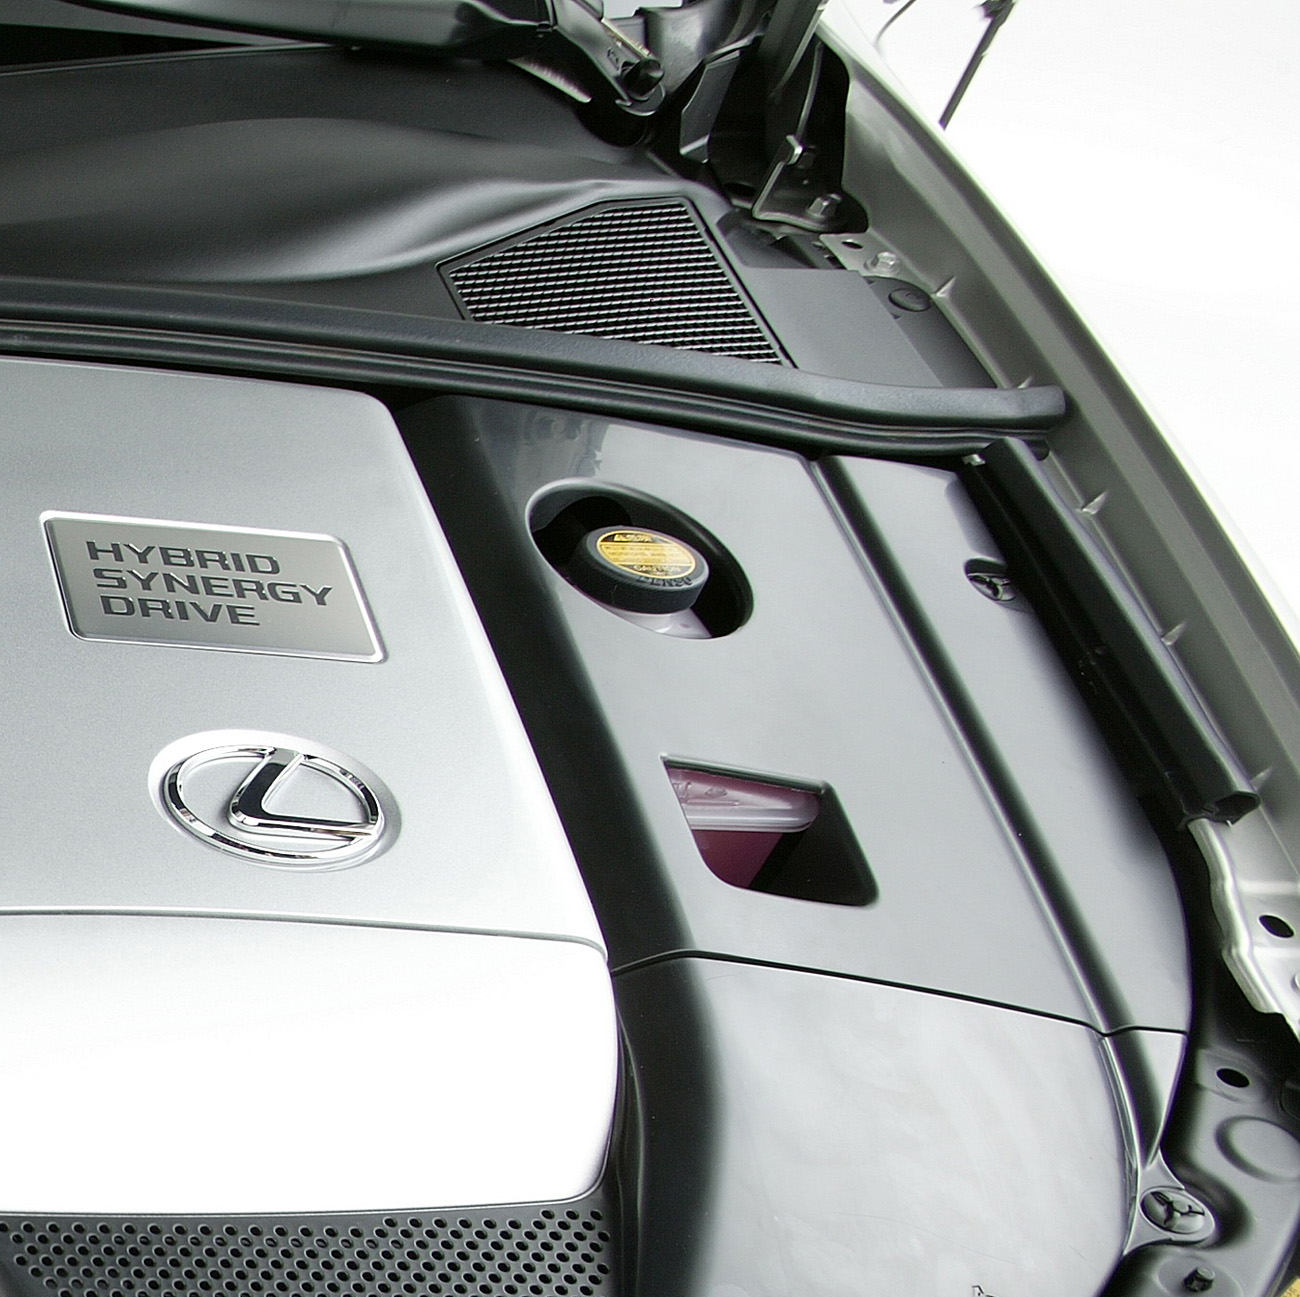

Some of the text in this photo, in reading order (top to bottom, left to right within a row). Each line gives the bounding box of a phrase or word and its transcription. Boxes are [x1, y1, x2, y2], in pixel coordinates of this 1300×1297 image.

[85, 540, 281, 576] HYBRID
[92, 567, 333, 607] SYNERGY
[98, 594, 261, 627] DRIVE
